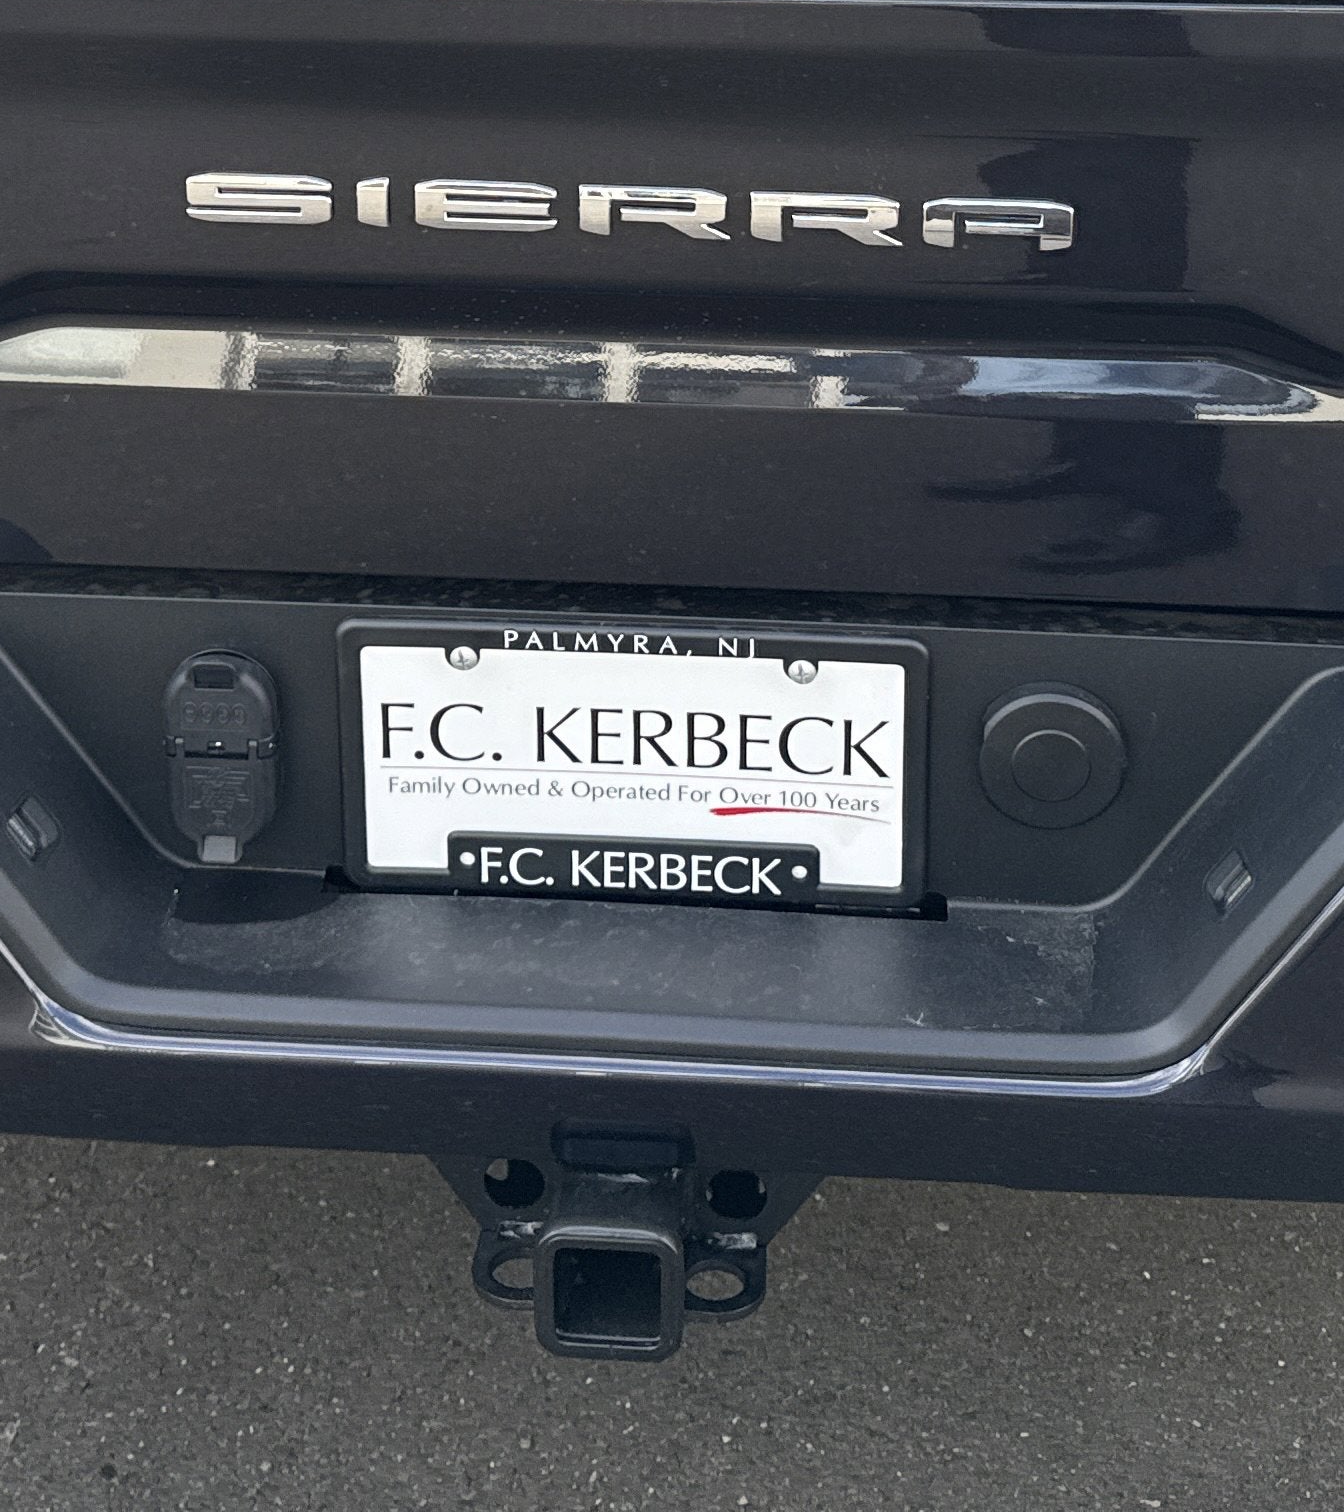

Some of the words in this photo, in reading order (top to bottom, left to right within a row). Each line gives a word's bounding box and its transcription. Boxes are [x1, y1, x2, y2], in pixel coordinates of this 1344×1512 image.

[184, 171, 1075, 252] SIERRA
[503, 629, 693, 657] PALMYRA,
[719, 637, 756, 658] NJ
[381, 702, 502, 762] F.C.
[535, 706, 891, 778] KERBECK
[388, 776, 455, 798] Family
[462, 777, 540, 797] Owned
[548, 780, 564, 797] &
[572, 780, 671, 804] Operated
[678, 786, 712, 804] For
[719, 786, 771, 806] Over
[779, 789, 817, 808] 100
[825, 792, 881, 813] Years
[480, 846, 555, 885] F.C.
[571, 851, 782, 896] KERBECK
